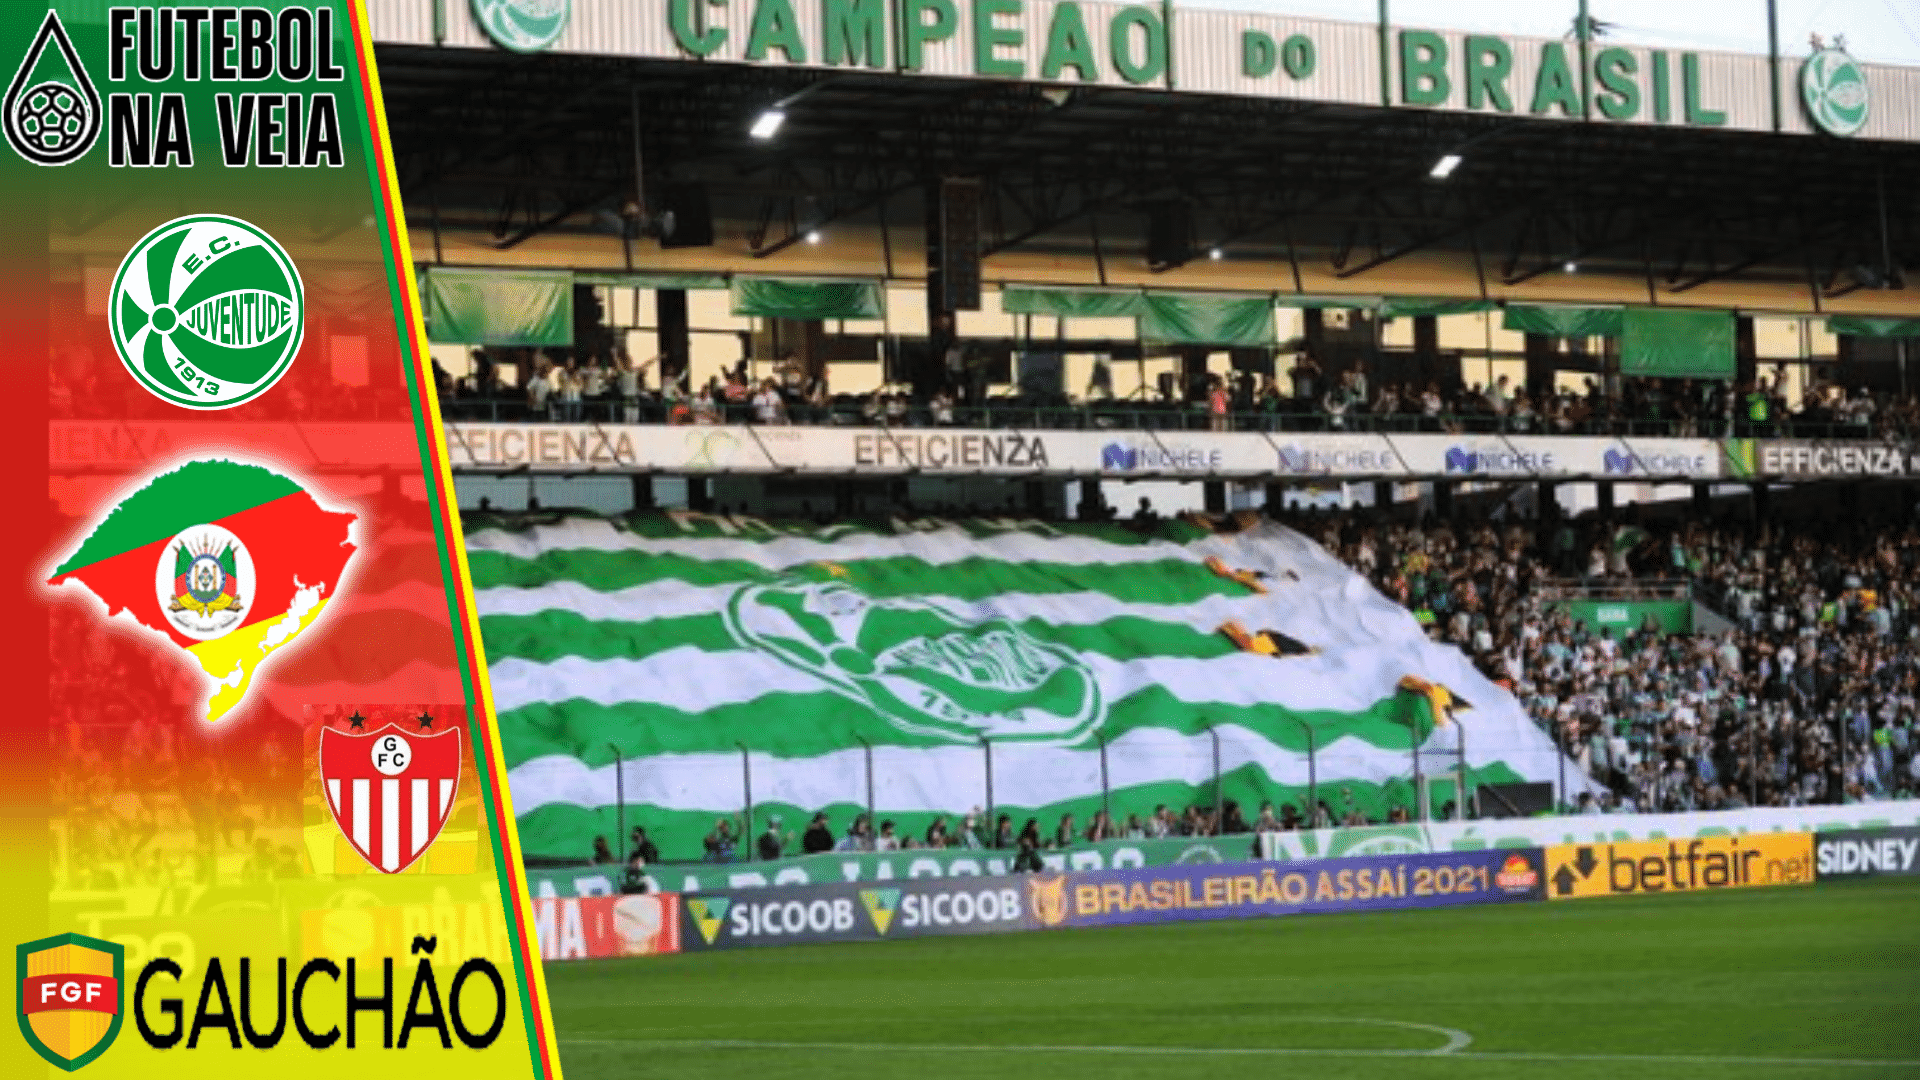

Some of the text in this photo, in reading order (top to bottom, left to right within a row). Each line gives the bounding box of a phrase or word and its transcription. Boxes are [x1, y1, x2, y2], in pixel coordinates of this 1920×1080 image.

[1242, 29, 1316, 79] DO
[1400, 29, 1727, 126] BRASIL
[854, 434, 1049, 466] EFFICIENZA
[1763, 446, 1906, 476] EFFICIENZA
[1817, 838, 1919, 875] SIDNEY
[901, 889, 1021, 927] SICOOB
[1076, 868, 1308, 916] BRASILEIRÃO
[1313, 863, 1407, 902] ASSAÍ
[1413, 865, 1490, 896] 2021
[731, 898, 854, 936] SICOOB
